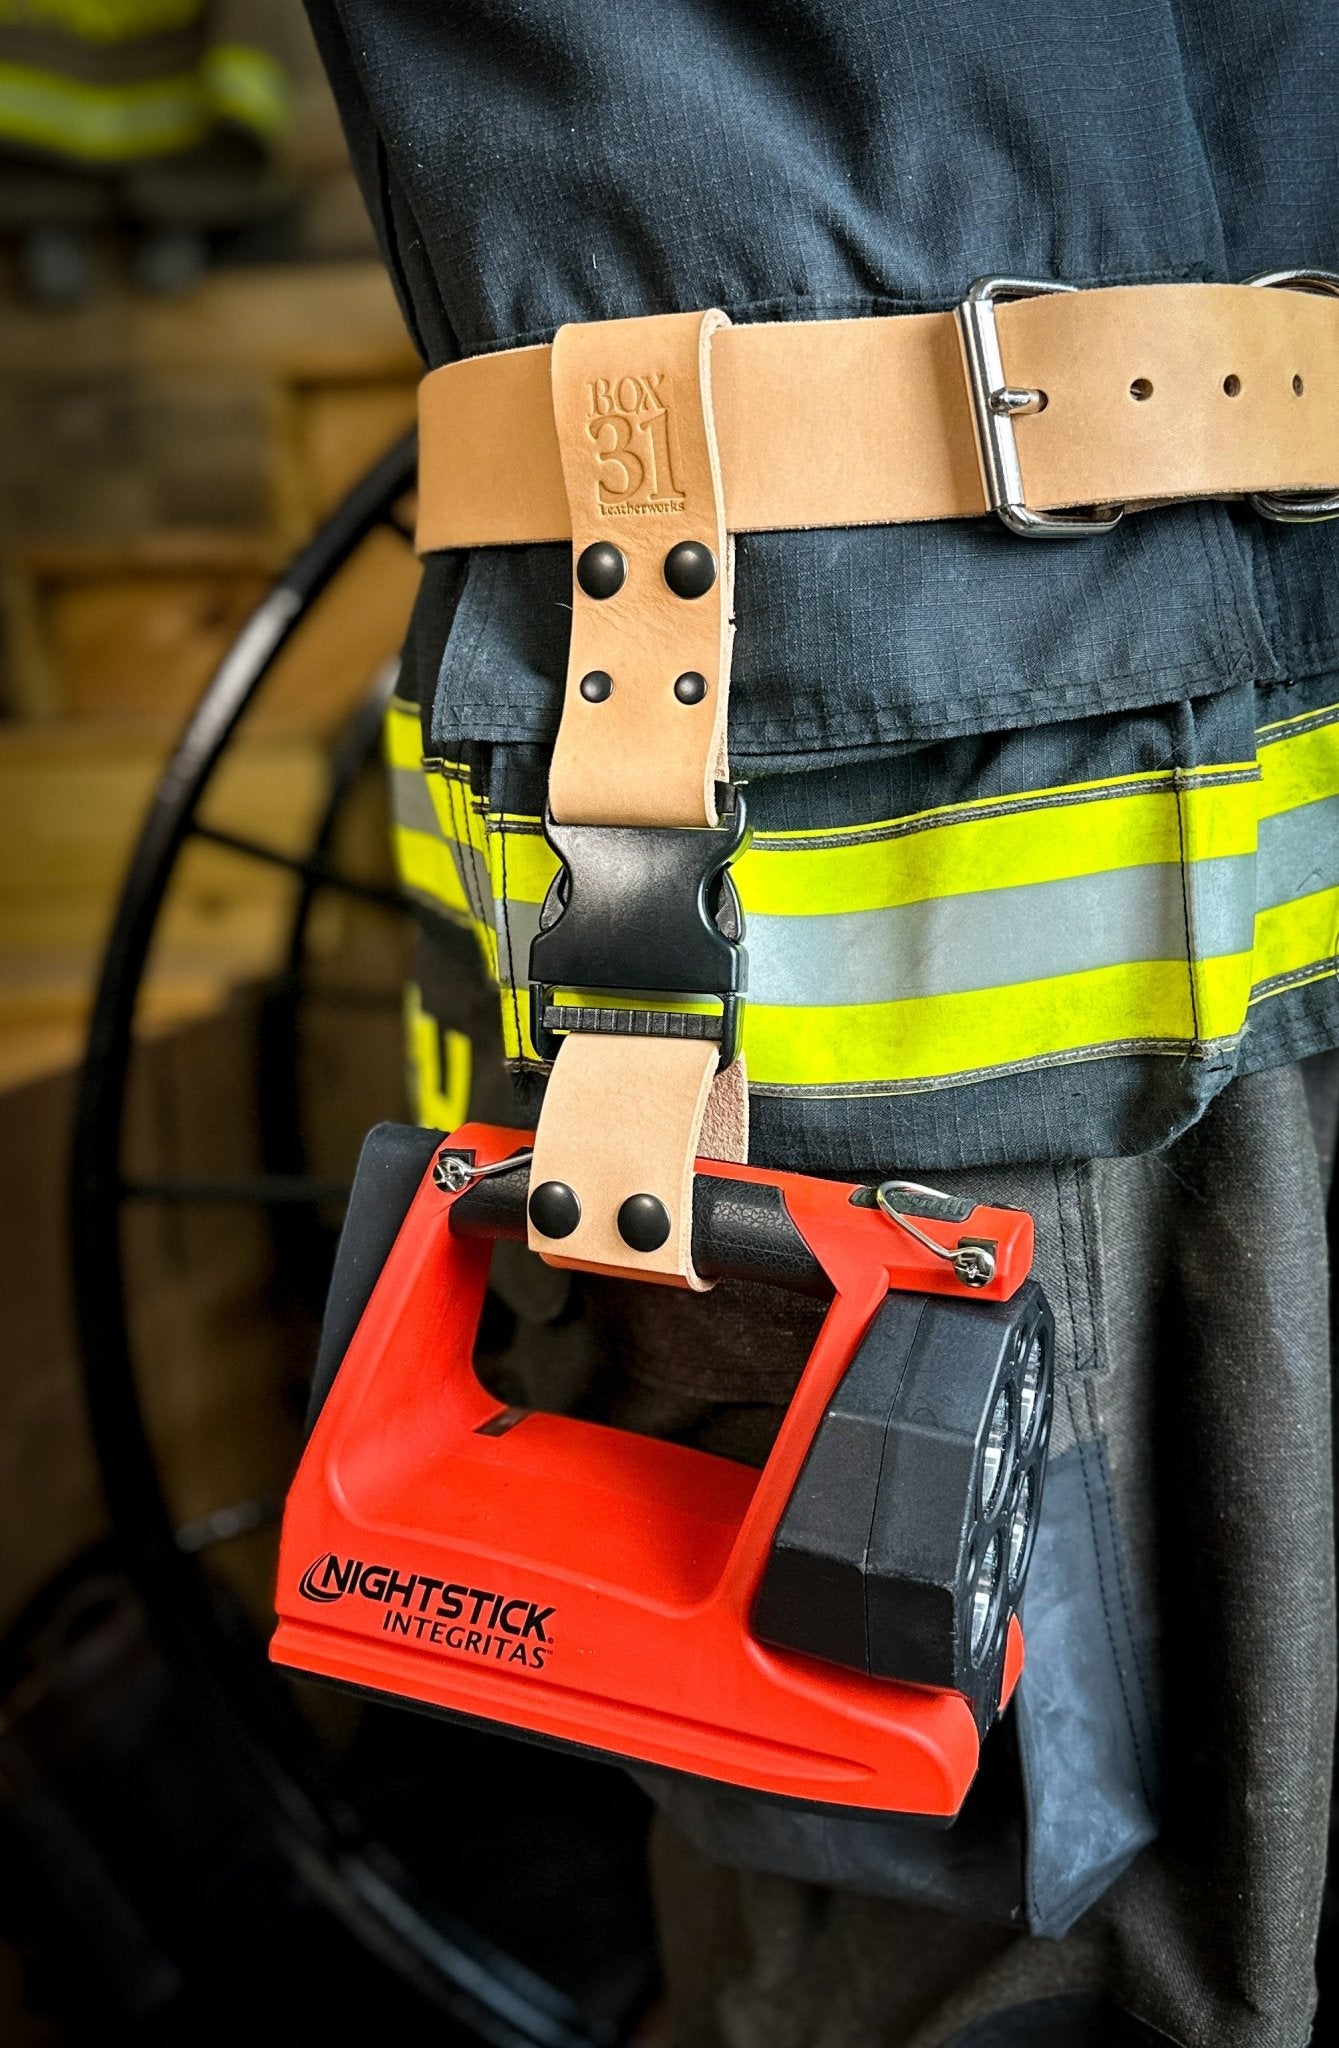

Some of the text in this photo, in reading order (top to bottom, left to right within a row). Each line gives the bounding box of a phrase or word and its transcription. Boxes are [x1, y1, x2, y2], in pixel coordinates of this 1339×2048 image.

[586, 374, 669, 417] BOX
[586, 411, 686, 504] 31
[599, 500, 685, 516] Leatherworks
[320, 1554, 557, 1643] NIGHTSTICK
[382, 1609, 546, 1669] INTEGRITAS
